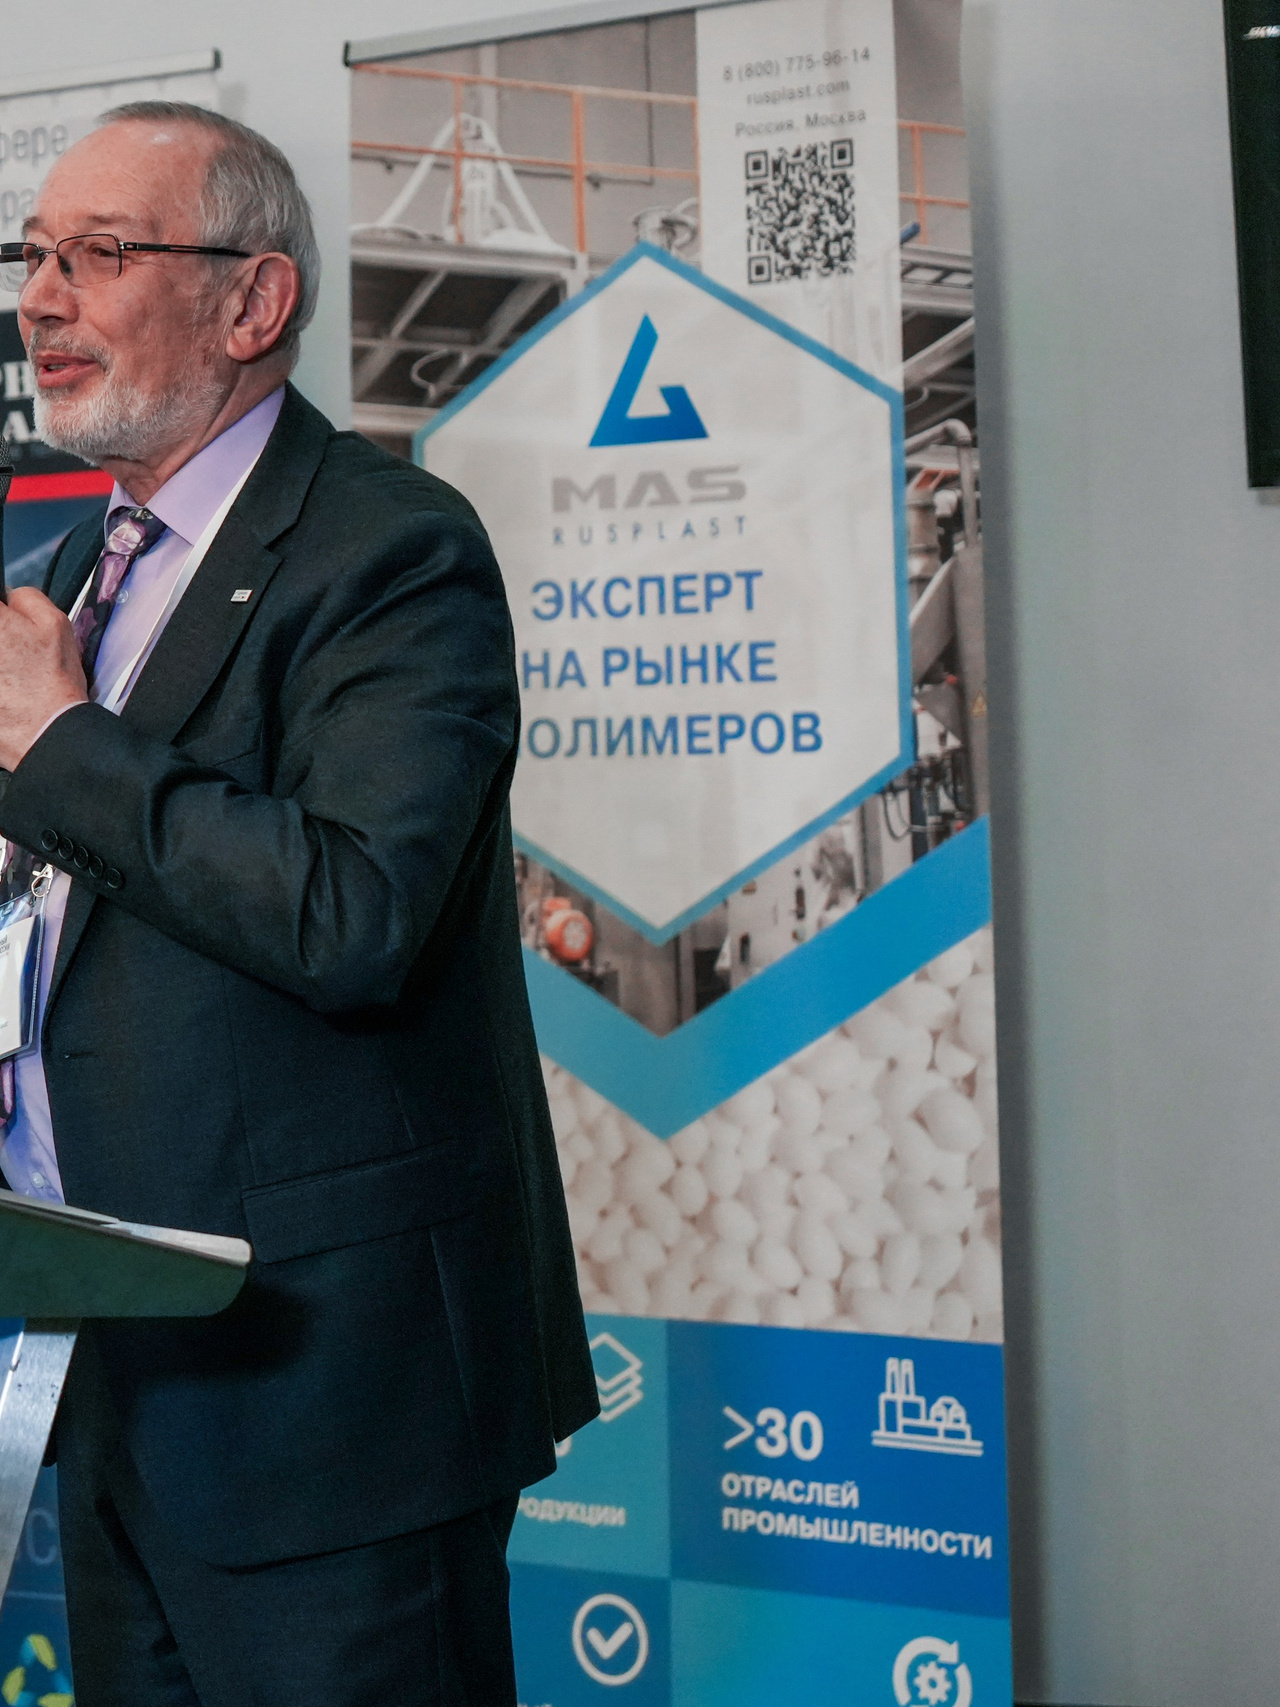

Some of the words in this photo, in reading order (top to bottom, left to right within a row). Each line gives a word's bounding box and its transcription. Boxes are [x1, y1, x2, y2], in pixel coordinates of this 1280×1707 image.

[738, 59, 781, 81] (800)
[747, 80, 850, 105] rusplast.com
[805, 108, 866, 129] Москва
[552, 464, 747, 514] MAS
[553, 515, 747, 547] RUSPLAST
[530, 569, 764, 622] ЭКСПЕРТ
[521, 649, 587, 690] НА
[602, 640, 778, 688] РЫНКЕ
[523, 711, 824, 760] ОЛИМЕРОВ
[721, 1404, 825, 1462] >30
[721, 1471, 860, 1511] ОТРАСЛЕЙ
[721, 1505, 994, 1561] ПРОМЫШЛЕННОСТИ
